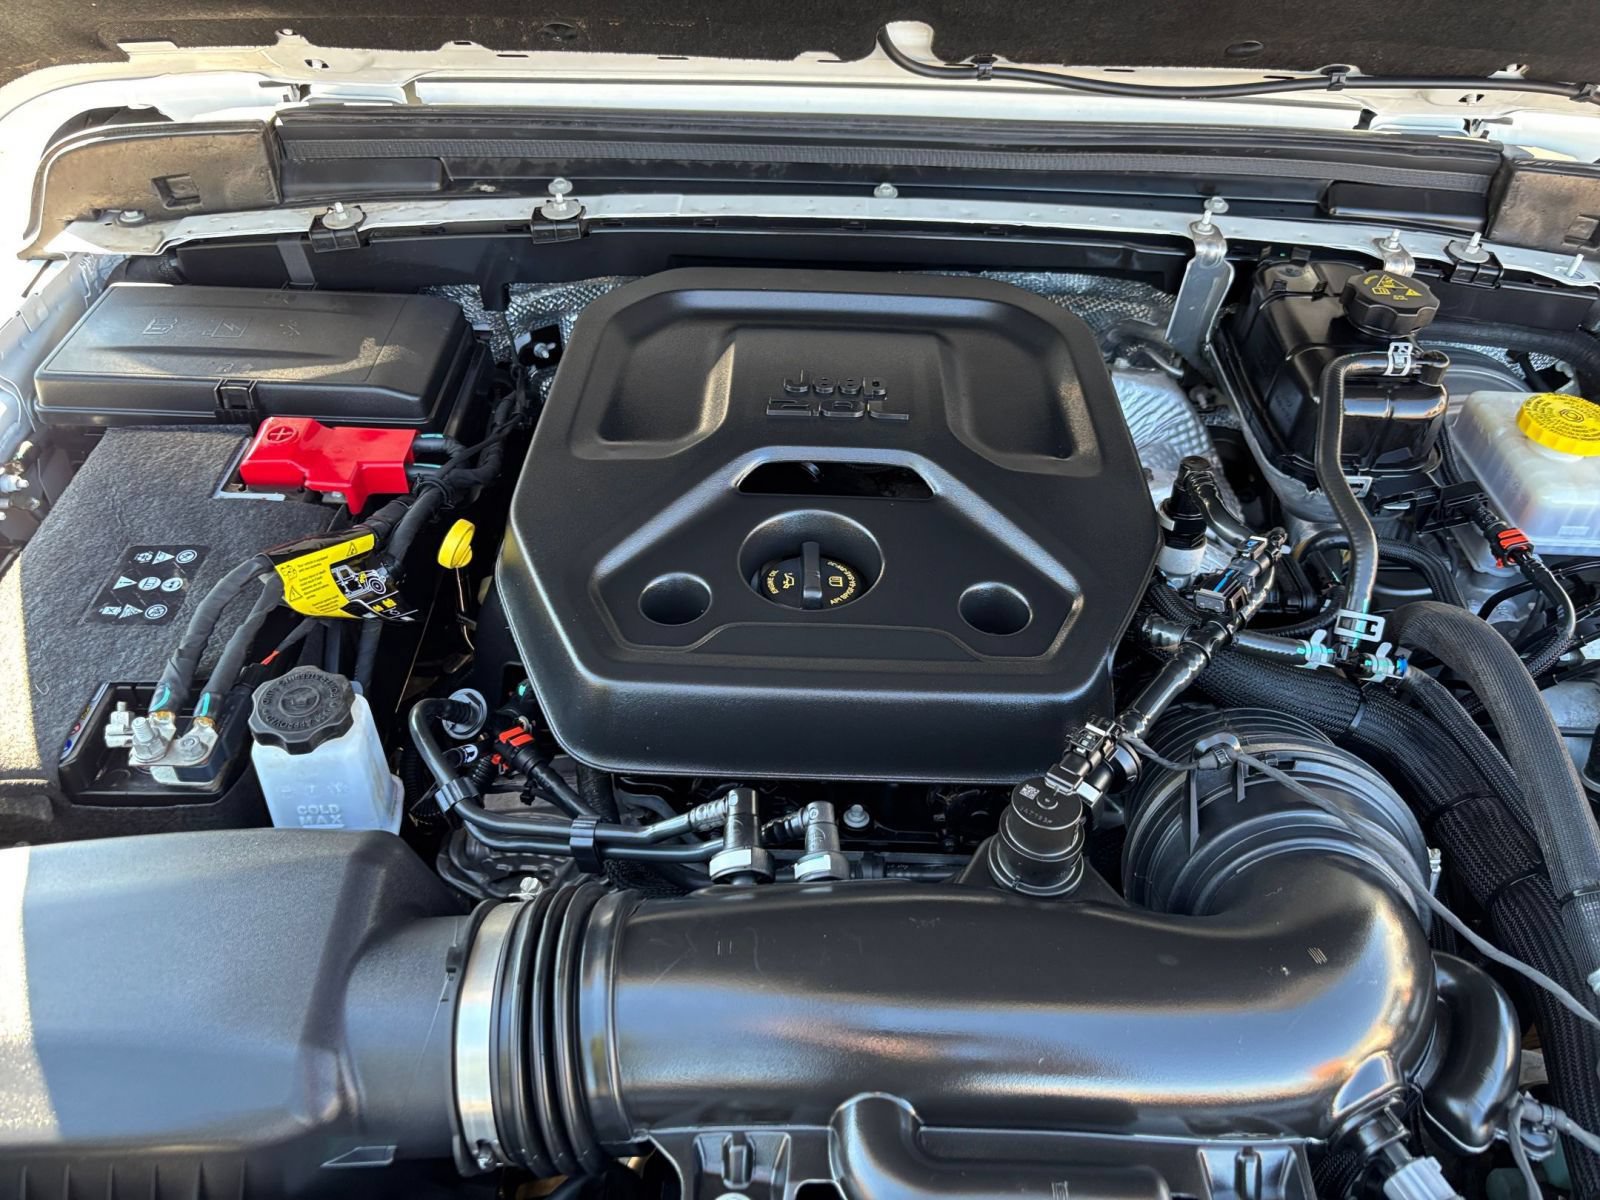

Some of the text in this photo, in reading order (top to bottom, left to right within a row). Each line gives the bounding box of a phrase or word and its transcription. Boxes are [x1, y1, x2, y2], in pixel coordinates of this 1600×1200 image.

[783, 369, 888, 400] Jeep
[766, 397, 910, 421] 2.0L
[296, 803, 341, 815] COLD
[298, 814, 343, 825] MAX
